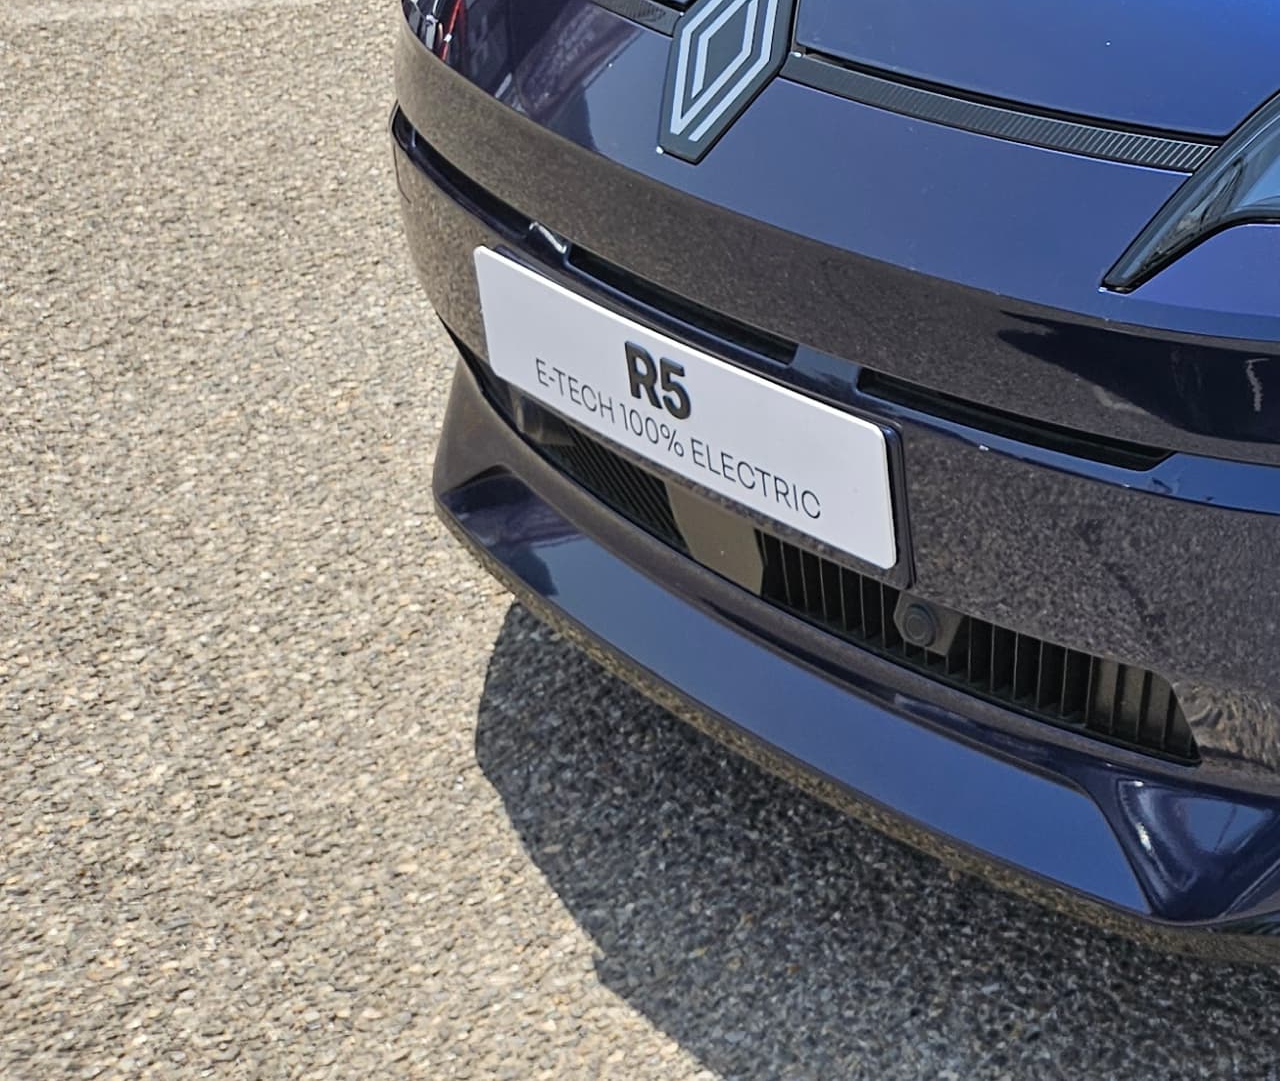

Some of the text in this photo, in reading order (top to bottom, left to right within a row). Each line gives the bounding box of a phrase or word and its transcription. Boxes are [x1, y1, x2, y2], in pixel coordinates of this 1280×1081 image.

[536, 357, 821, 520] E-TECH 100% ELECTRIC
[625, 341, 691, 419] R5
